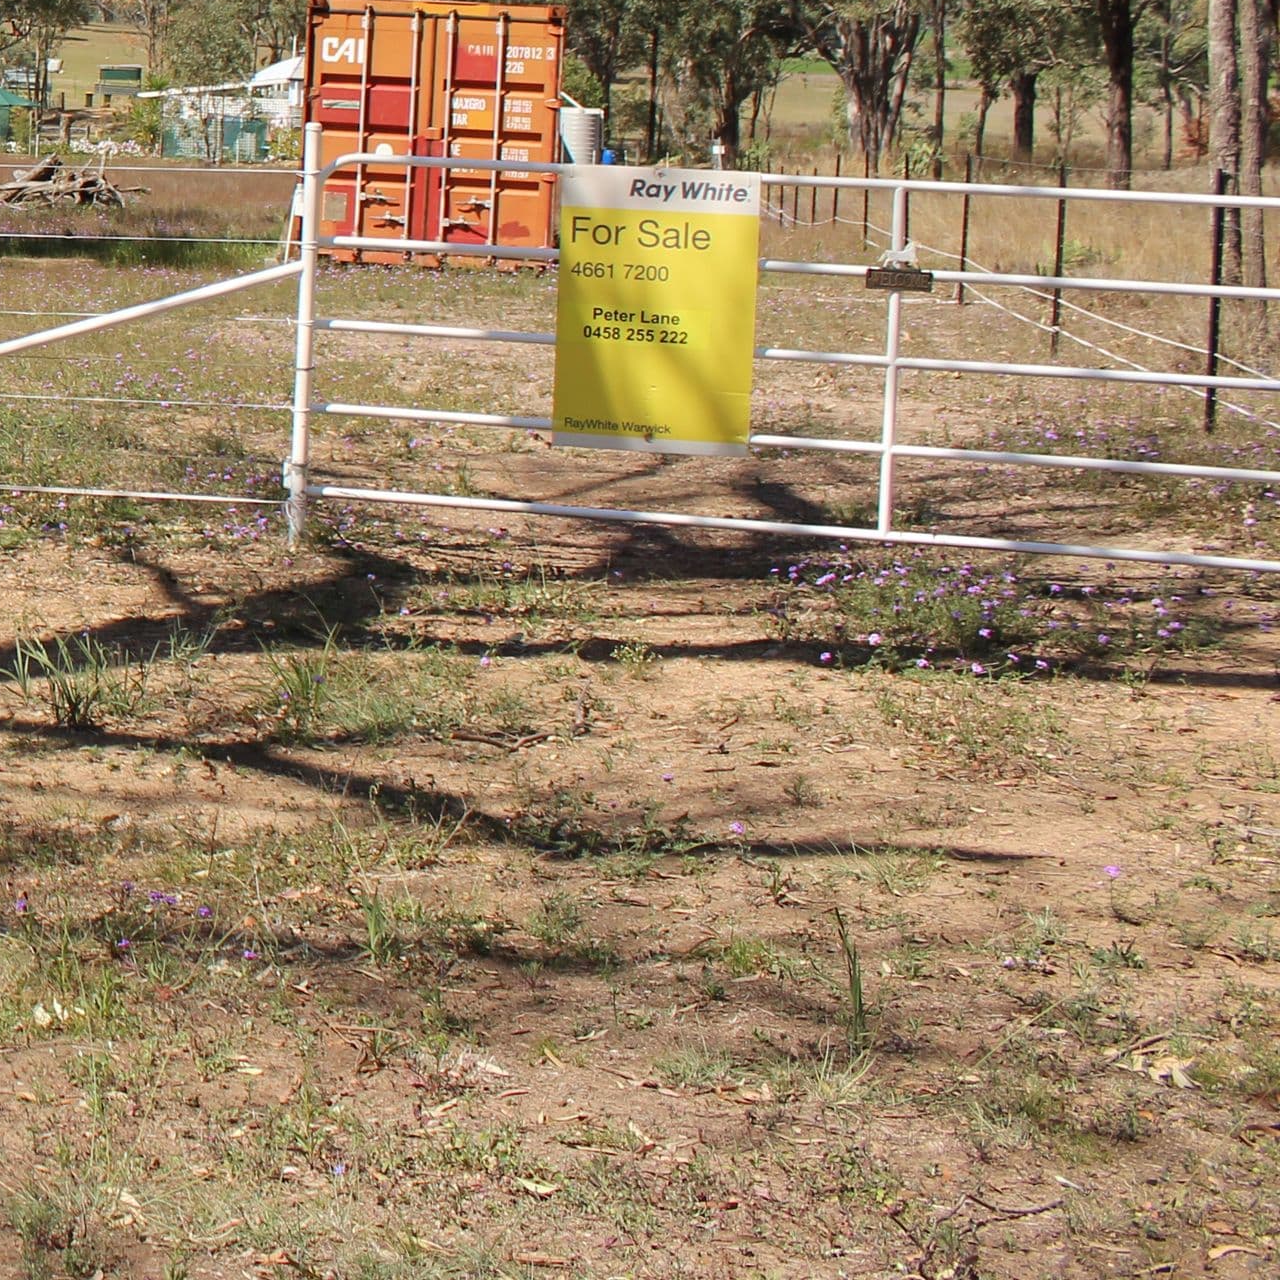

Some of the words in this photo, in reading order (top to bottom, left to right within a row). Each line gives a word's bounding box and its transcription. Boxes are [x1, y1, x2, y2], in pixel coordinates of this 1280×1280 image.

[506, 46, 543, 60] 207812
[630, 179, 676, 202] Ray
[681, 181, 748, 202] White
[571, 216, 626, 246] For
[637, 219, 711, 250] Sale
[570, 262, 614, 279] 4661
[624, 264, 669, 282] 7200
[593, 307, 636, 322] Peter
[641, 310, 680, 325] Lane
[583, 325, 620, 340] 0458
[627, 328, 654, 342] 255
[659, 330, 688, 344] 222
[564, 417, 619, 431] RayWhite
[621, 421, 671, 434] Warwick
